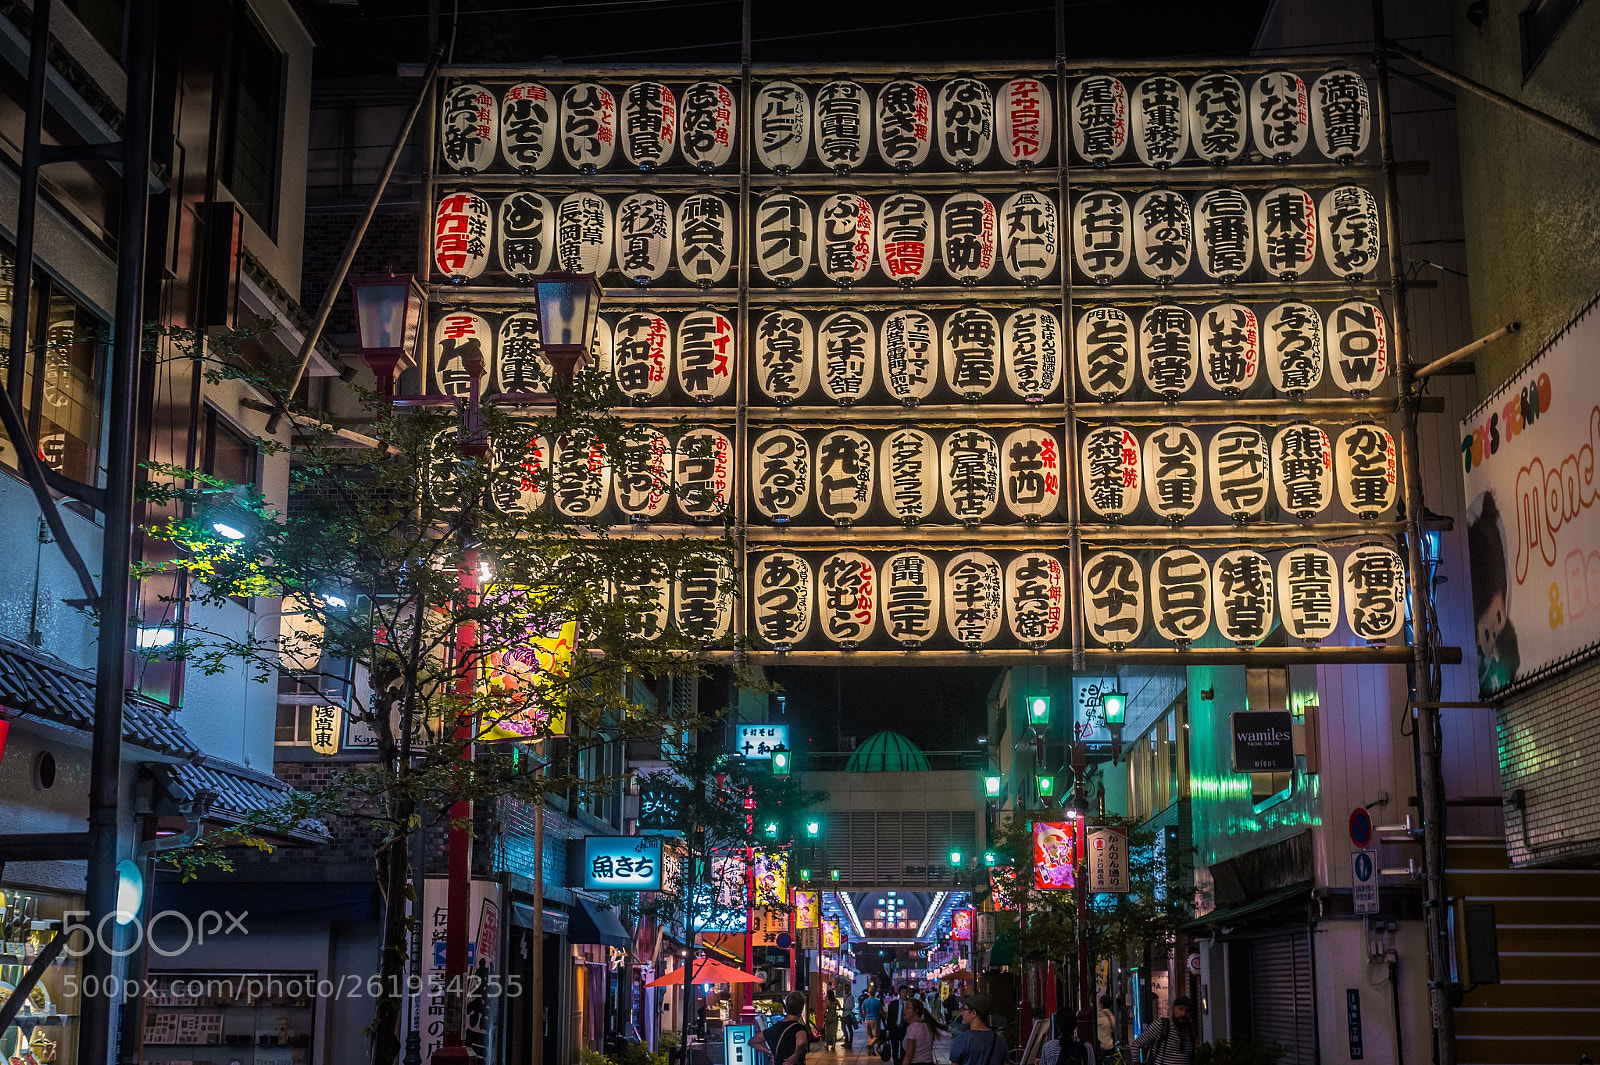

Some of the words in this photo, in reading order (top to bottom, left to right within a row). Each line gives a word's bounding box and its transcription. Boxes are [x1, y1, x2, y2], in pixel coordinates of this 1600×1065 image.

[476, 91, 492, 141] 御料理
[505, 87, 548, 102] 浅草
[565, 87, 602, 160] ひらい
[762, 87, 794, 153] マルビシ
[818, 83, 862, 162] 村石電気
[881, 83, 917, 158] 魚きち
[945, 80, 982, 156] なか山
[1078, 79, 1116, 155] 尾張屋
[1142, 79, 1181, 160] 中山事務所
[1260, 75, 1299, 148] いなば
[621, 199, 654, 271] 彩夏
[652, 199, 667, 238] 甘味処
[824, 196, 858, 274] ふじ屋
[945, 200, 983, 273] 百助
[1006, 206, 1047, 272] 丸仁
[1140, 195, 1187, 270] 鉢の木
[1266, 193, 1307, 269] 東洋
[1328, 208, 1368, 272] たけや
[616, 315, 650, 390] 十和田
[647, 317, 668, 381] 手打そば
[760, 313, 803, 394] 和泉屋
[822, 313, 869, 394] 今半別館
[907, 314, 930, 385] ファミリーマート
[948, 311, 995, 388] 梅屋
[1143, 308, 1191, 389] 桐生堂
[1243, 309, 1256, 377] 浅草のり
[1336, 308, 1377, 384] NOW
[757, 436, 797, 513] つるや
[949, 432, 987, 514] 辻屋本店
[1040, 438, 1058, 494] 茶処
[1087, 430, 1125, 510] 木村家本舗
[1120, 431, 1136, 489] 人形焼
[1152, 432, 1197, 511] ひろ里
[1280, 428, 1323, 509] 熊野屋
[1345, 428, 1388, 509] かと里
[1462, 412, 1499, 474] TOYS
[757, 556, 799, 639] あづま
[823, 557, 862, 638] 松むら
[858, 562, 872, 625] とんかつ
[887, 556, 931, 637] 雷門三定
[949, 559, 986, 640] 今半本店
[314, 704, 333, 748] 浅草東
[742, 728, 775, 738] 手打そば
[1237, 728, 1290, 742] wamiles
[592, 855, 654, 879] 魚きち
[1107, 834, 1120, 887] かんのん通り
[1352, 1047, 1362, 1055] 32
